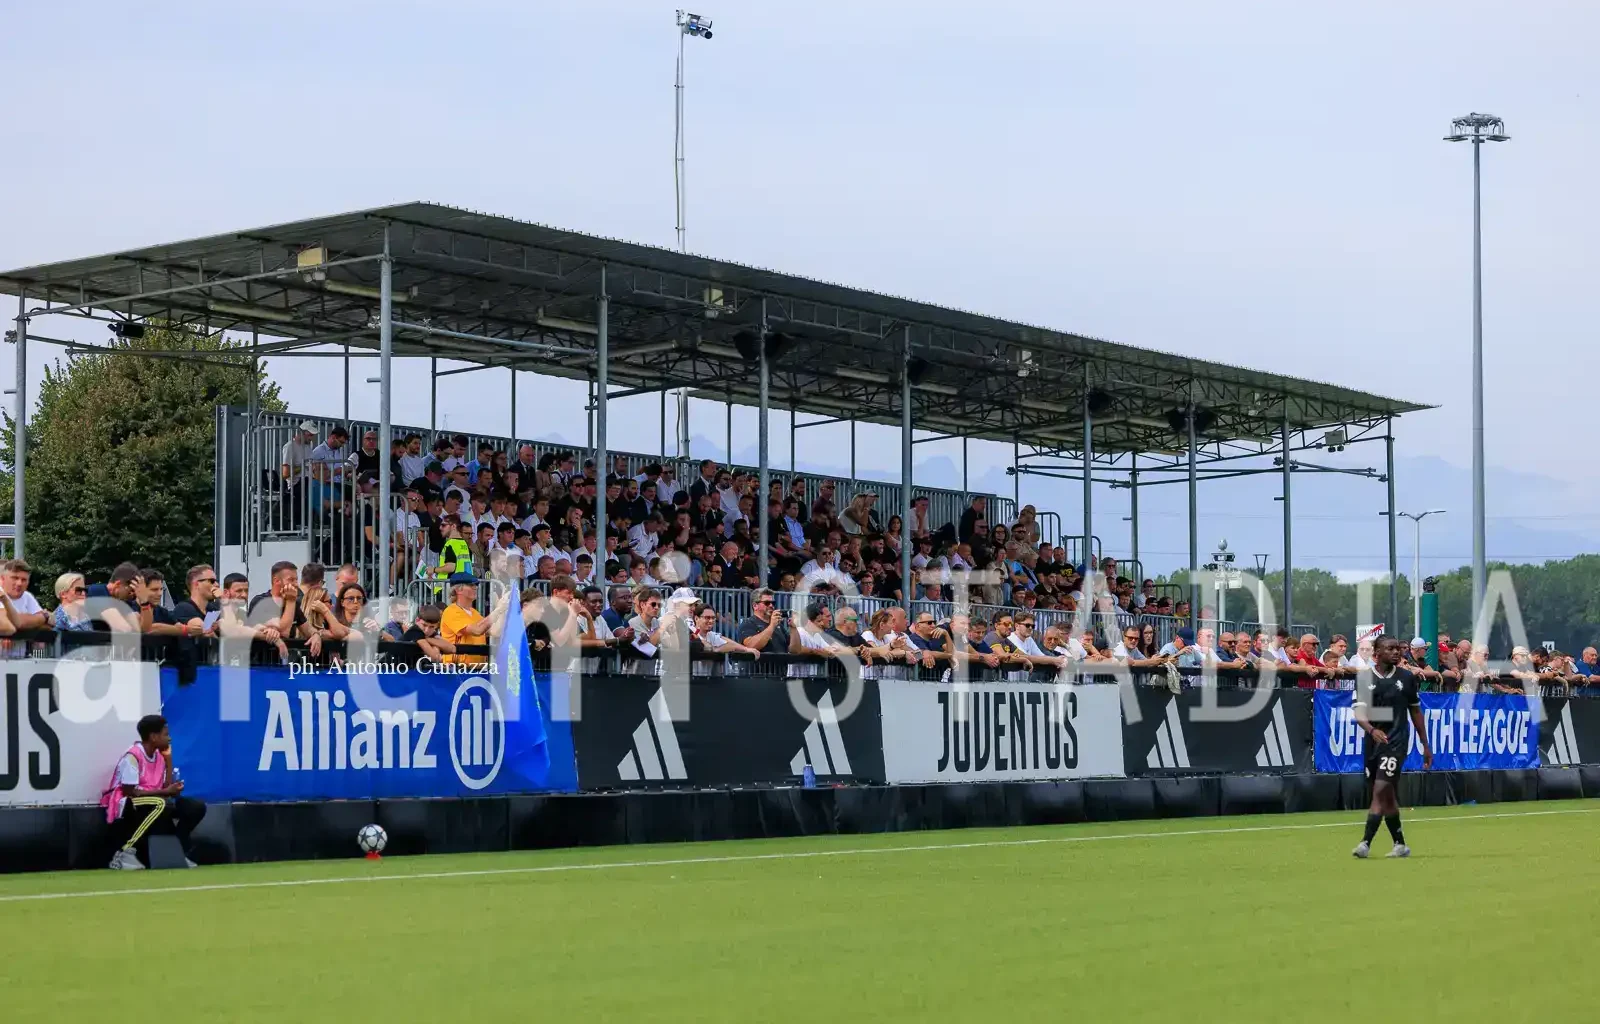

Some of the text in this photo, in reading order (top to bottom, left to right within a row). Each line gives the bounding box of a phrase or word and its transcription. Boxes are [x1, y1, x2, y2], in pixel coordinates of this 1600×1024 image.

[258, 690, 437, 771] Allianz
[937, 691, 1078, 773] JUVENTUS
[1329, 707, 1365, 756] UEF
[1459, 708, 1530, 754] LEAGUE
[1380, 757, 1397, 771] 26
